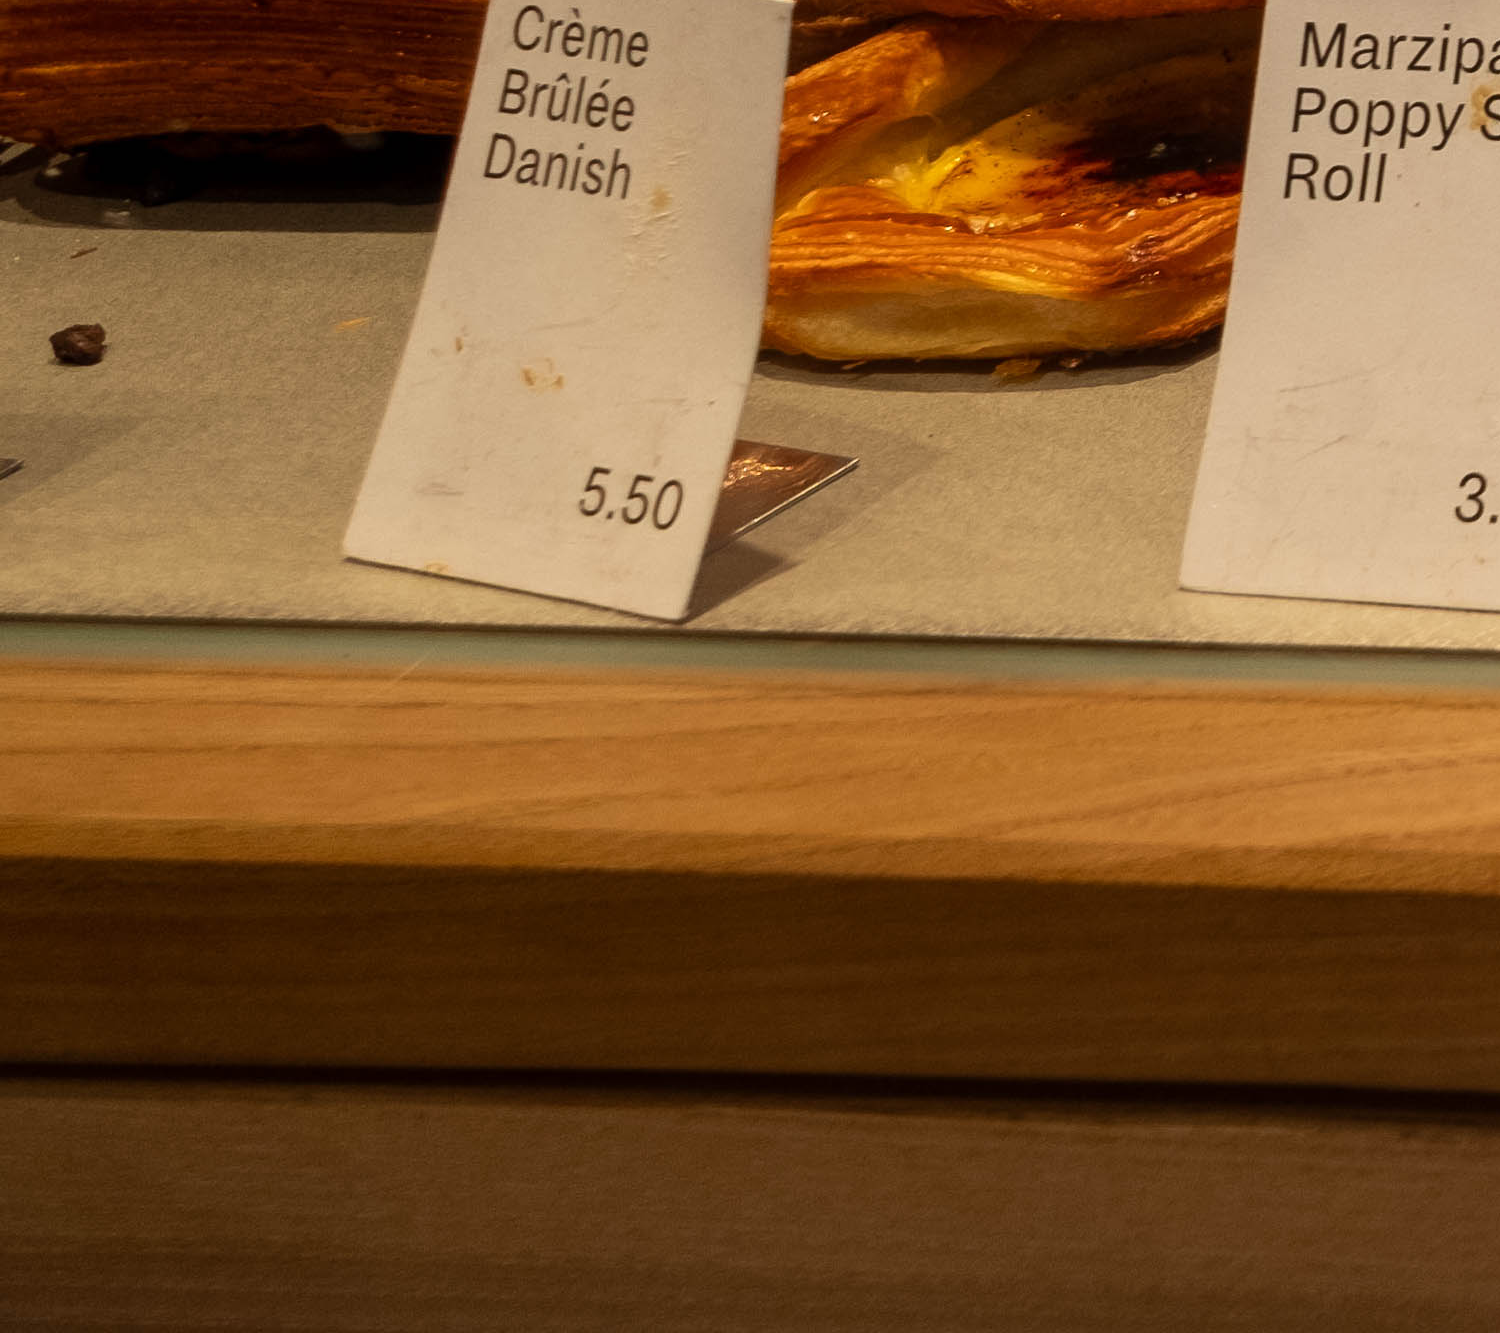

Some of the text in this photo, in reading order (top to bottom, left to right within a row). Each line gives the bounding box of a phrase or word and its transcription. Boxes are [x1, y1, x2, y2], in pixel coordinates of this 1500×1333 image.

[512, 4, 649, 72] Crème
[497, 68, 635, 132] Brûlée
[1291, 86, 1465, 152] Poppy
[483, 128, 631, 200] Danish
[1283, 152, 1388, 203] Roll
[579, 466, 684, 531] 5.50
